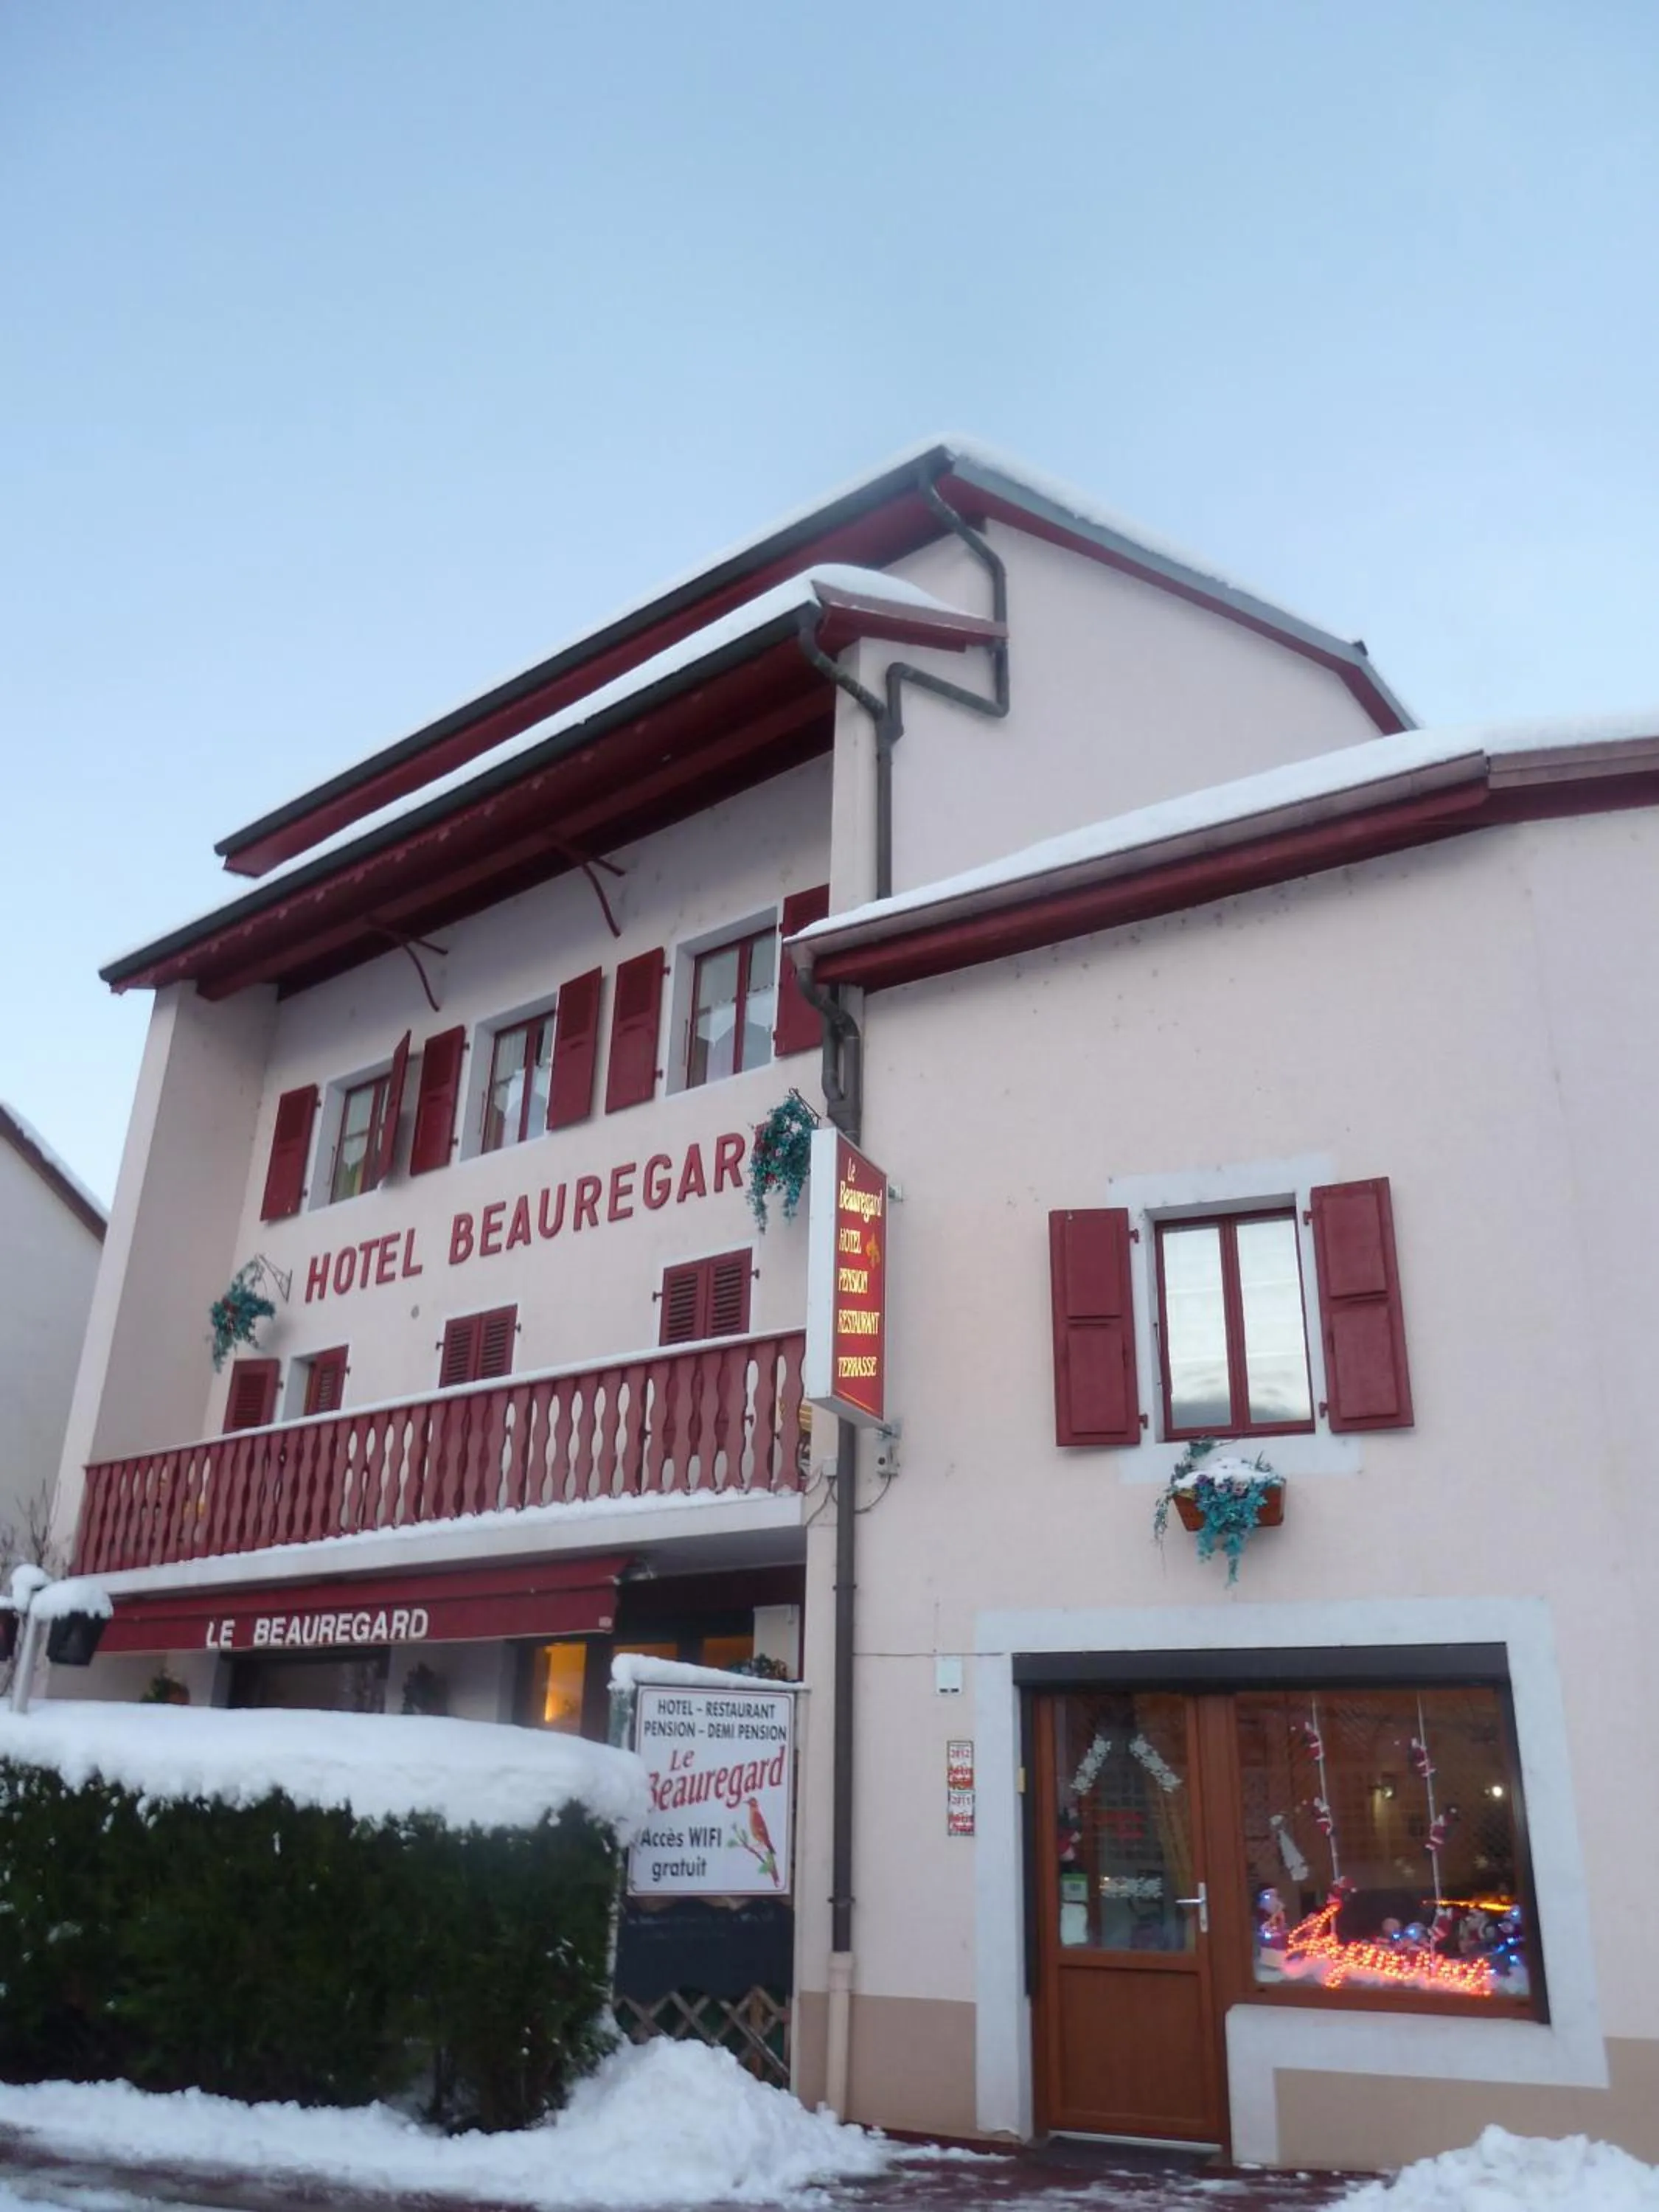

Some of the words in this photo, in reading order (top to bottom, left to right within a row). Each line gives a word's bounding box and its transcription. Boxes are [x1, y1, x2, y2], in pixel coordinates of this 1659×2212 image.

[847, 1157, 855, 1183] Le
[839, 1180, 883, 1223] Beauregard
[838, 1228, 862, 1255] HOTEL
[304, 1228, 423, 1304] HOTEL
[838, 1267, 869, 1294] PENSION
[838, 1309, 880, 1335] RESTAURANT
[838, 1356, 877, 1378] TERRASSE
[206, 1619, 235, 1649] LE
[253, 1608, 428, 1646] BEAUREGARD
[658, 1699, 694, 1717] HOTEL
[705, 1701, 776, 1719] RESTAURANT
[644, 1720, 696, 1738] PENSION
[707, 1724, 735, 1739] DEMI
[738, 1725, 787, 1741] PENSION
[670, 1750, 695, 1771] Le
[640, 1829, 684, 1848] Accès
[689, 1826, 722, 1847] WIFI
[652, 1857, 707, 1882] gratuit
